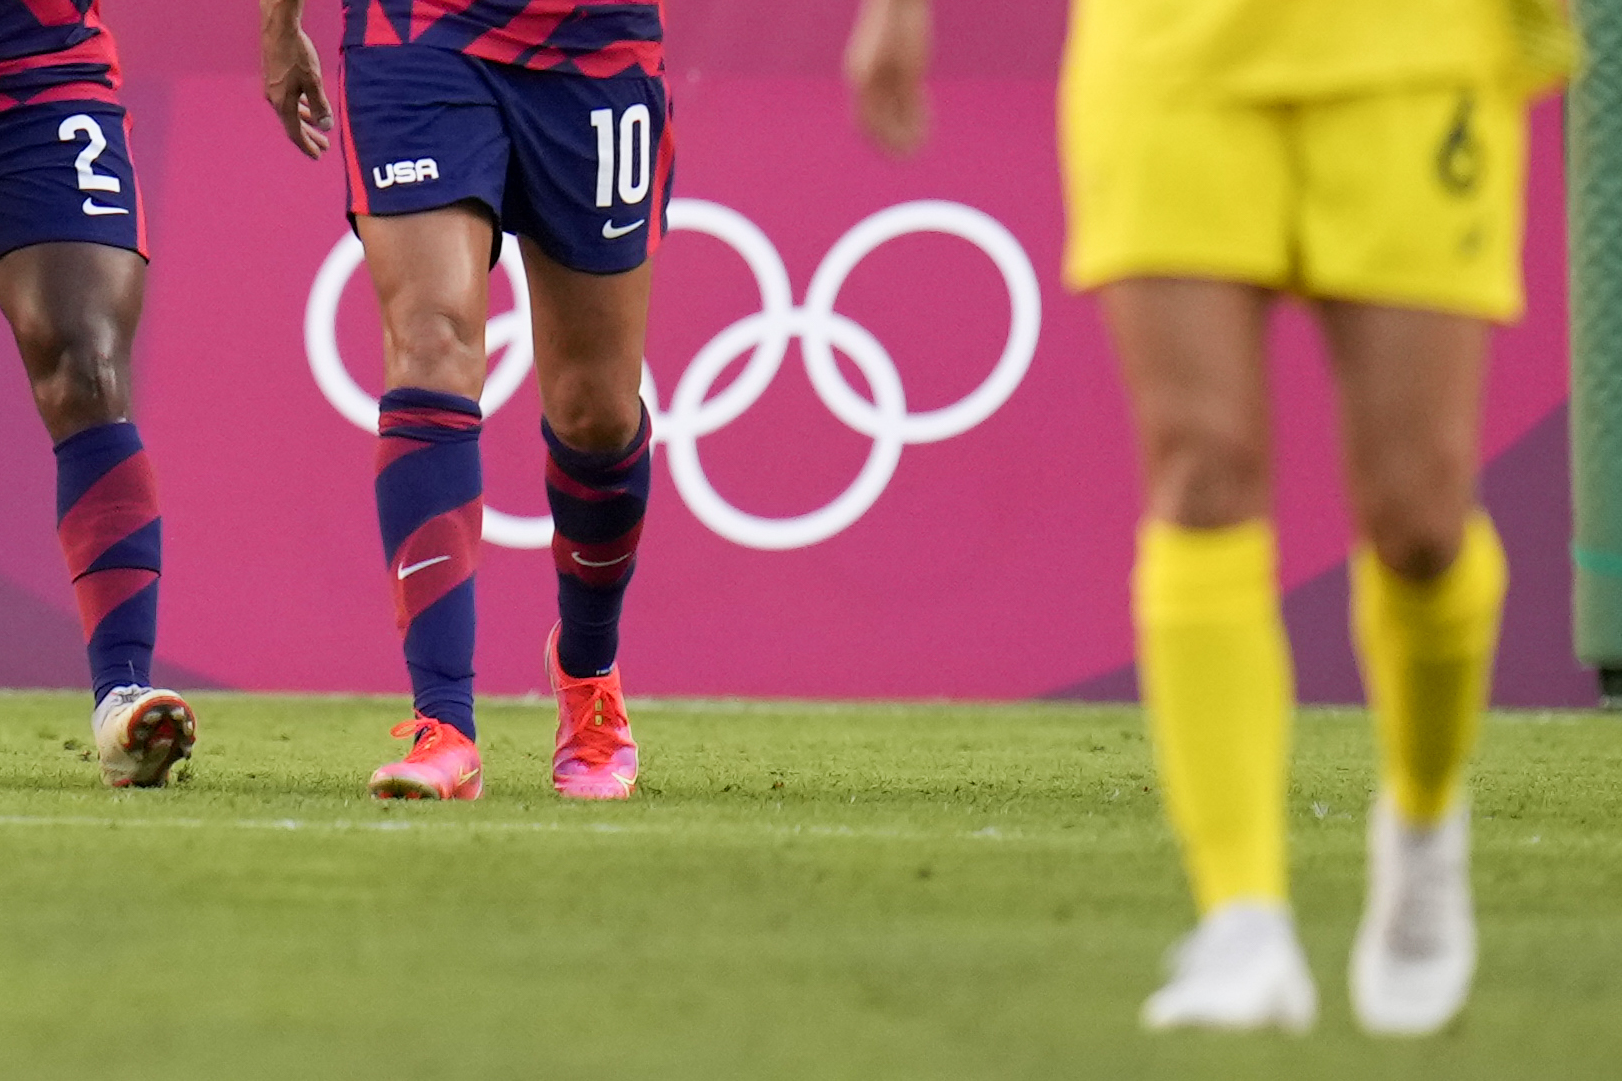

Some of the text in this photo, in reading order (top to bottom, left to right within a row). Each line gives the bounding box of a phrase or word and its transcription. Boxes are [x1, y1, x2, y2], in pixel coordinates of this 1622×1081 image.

[58, 114, 121, 193] 2
[372, 157, 440, 189] USA
[590, 103, 651, 207] 10
[1433, 88, 1487, 199] 6
